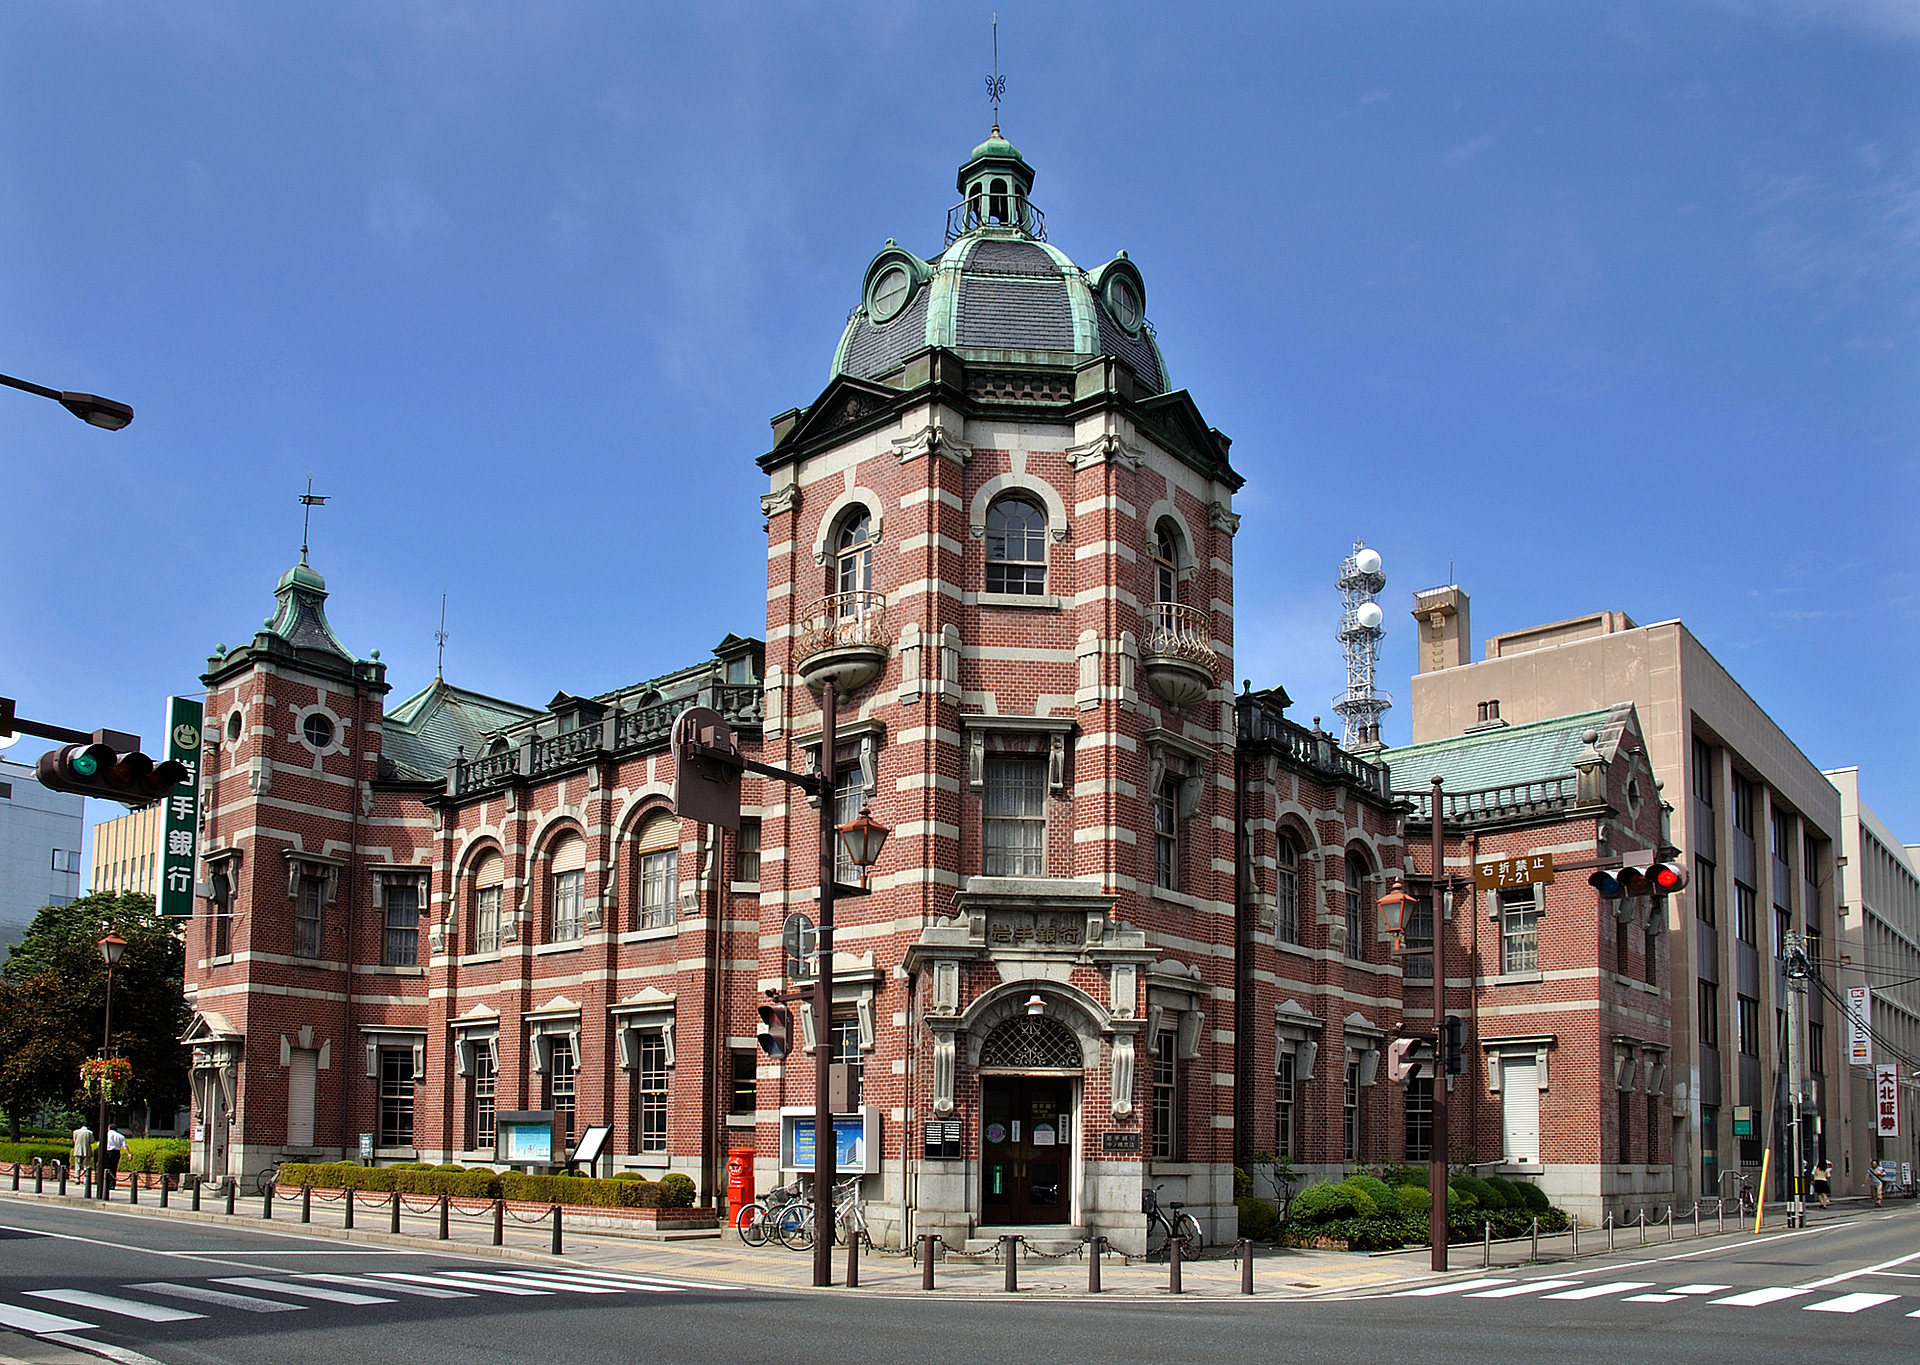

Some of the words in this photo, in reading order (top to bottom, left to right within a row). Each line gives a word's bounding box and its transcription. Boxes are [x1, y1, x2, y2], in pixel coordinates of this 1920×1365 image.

[1481, 857, 1545, 876] 右折禁止
[1498, 870, 1530, 886] 7-21
[993, 924, 1078, 943] 岩手銀行
[1854, 1000, 1863, 1013] DC
[1879, 1071, 1895, 1130] 大北証券
